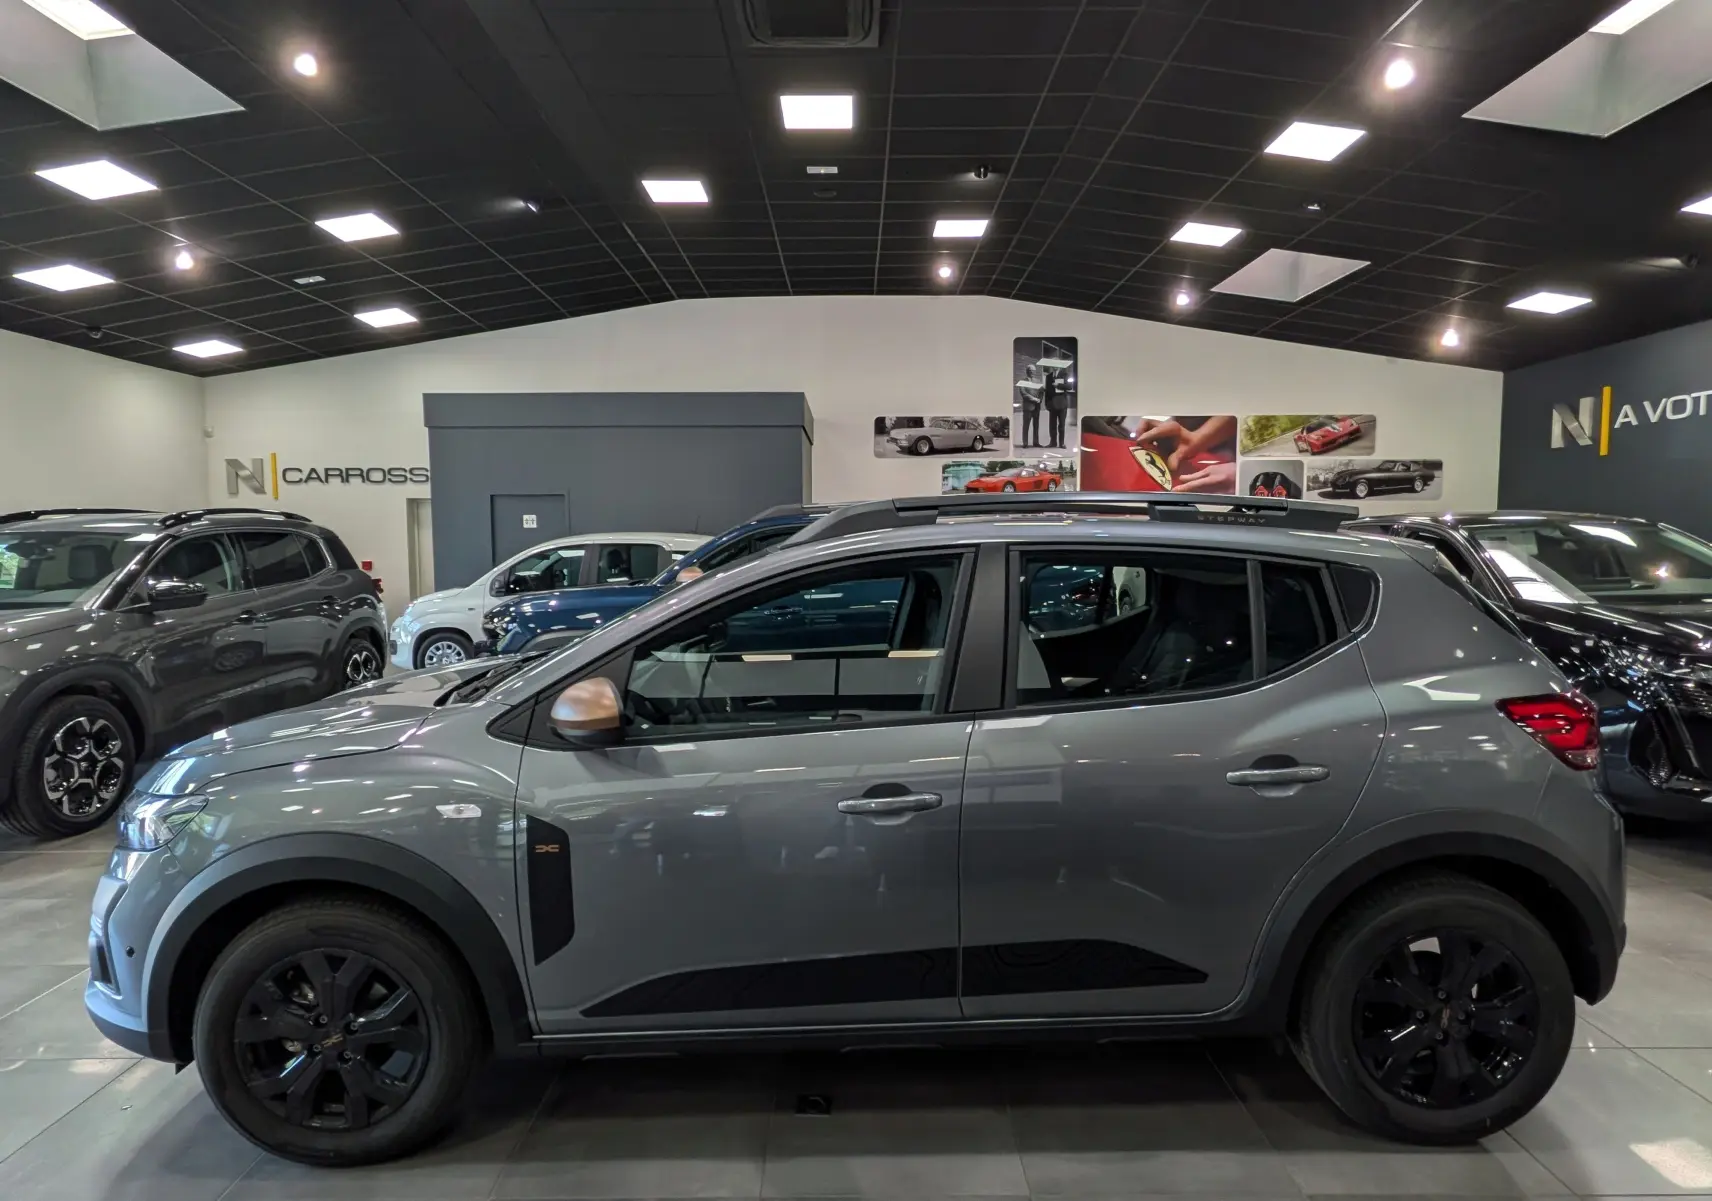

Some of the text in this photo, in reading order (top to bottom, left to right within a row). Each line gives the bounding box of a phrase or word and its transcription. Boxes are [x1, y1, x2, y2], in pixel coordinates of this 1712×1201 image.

[1614, 404, 1639, 429] A
[1643, 390, 1712, 423] VOT
[282, 467, 430, 484] CARROSS
[1198, 515, 1265, 523] STEPWAY
